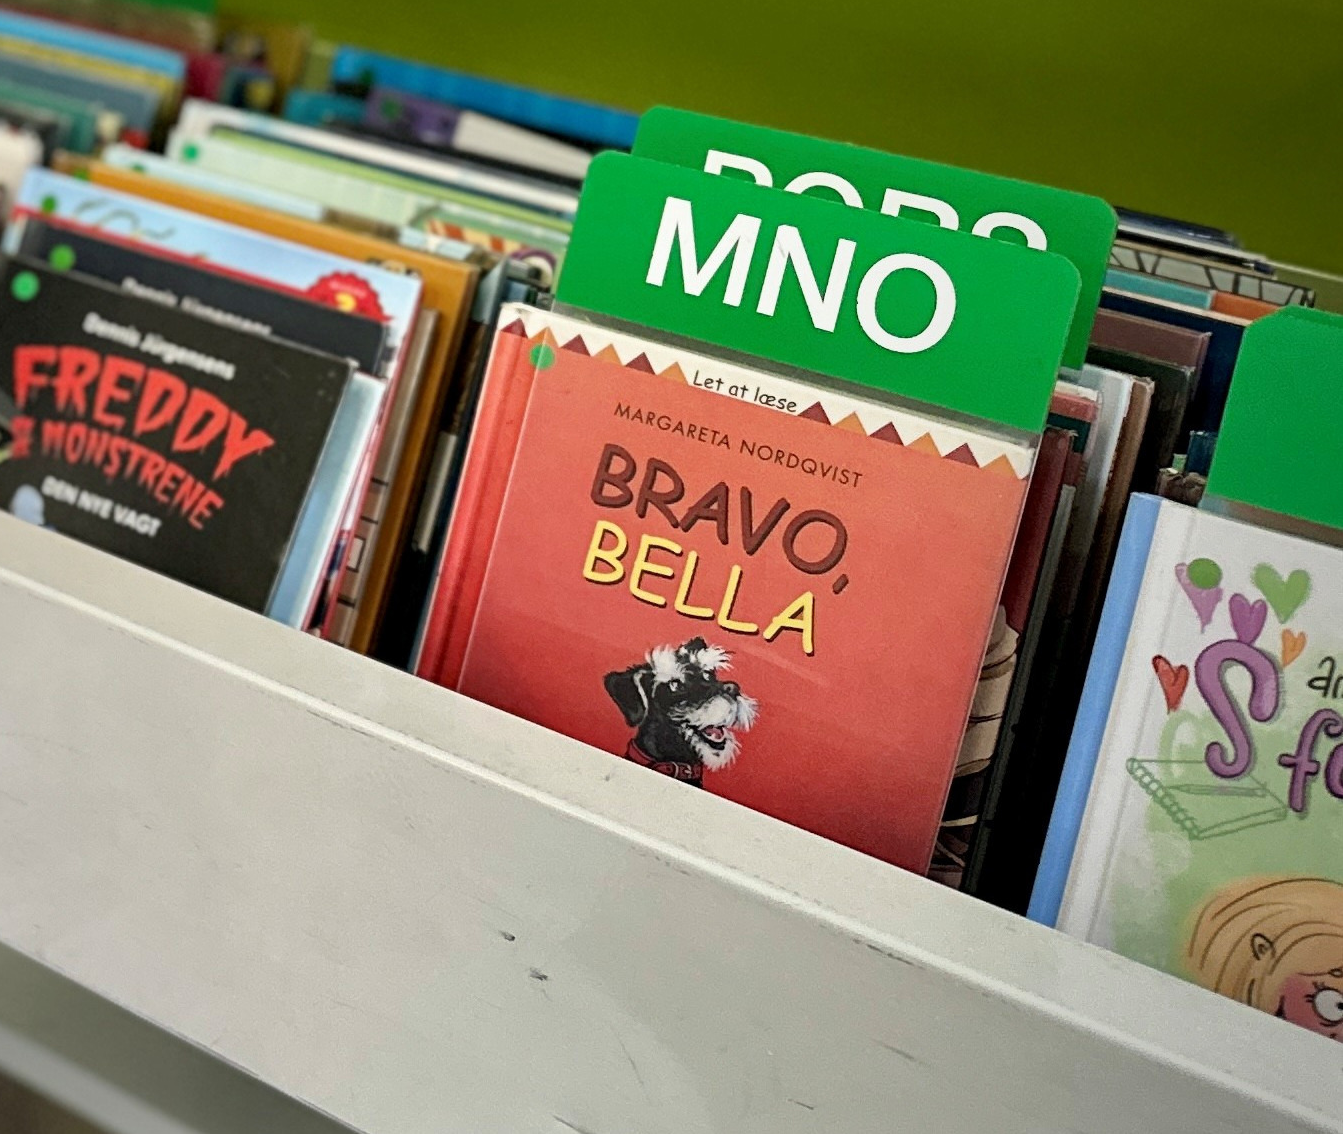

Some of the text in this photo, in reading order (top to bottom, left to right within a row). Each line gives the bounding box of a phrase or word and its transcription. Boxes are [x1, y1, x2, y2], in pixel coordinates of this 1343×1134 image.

[645, 195, 957, 354] MNO
[82, 311, 141, 351] Dennis
[13, 344, 275, 482] FREDDY
[614, 402, 864, 489] MARGARETA NORDQVIST
[692, 369, 798, 414] Let at læse
[41, 419, 226, 530] MONSTRENE
[41, 475, 162, 537] DEN NYE VAGT
[590, 443, 850, 594] BRAVO,
[581, 520, 817, 654] BELLA
